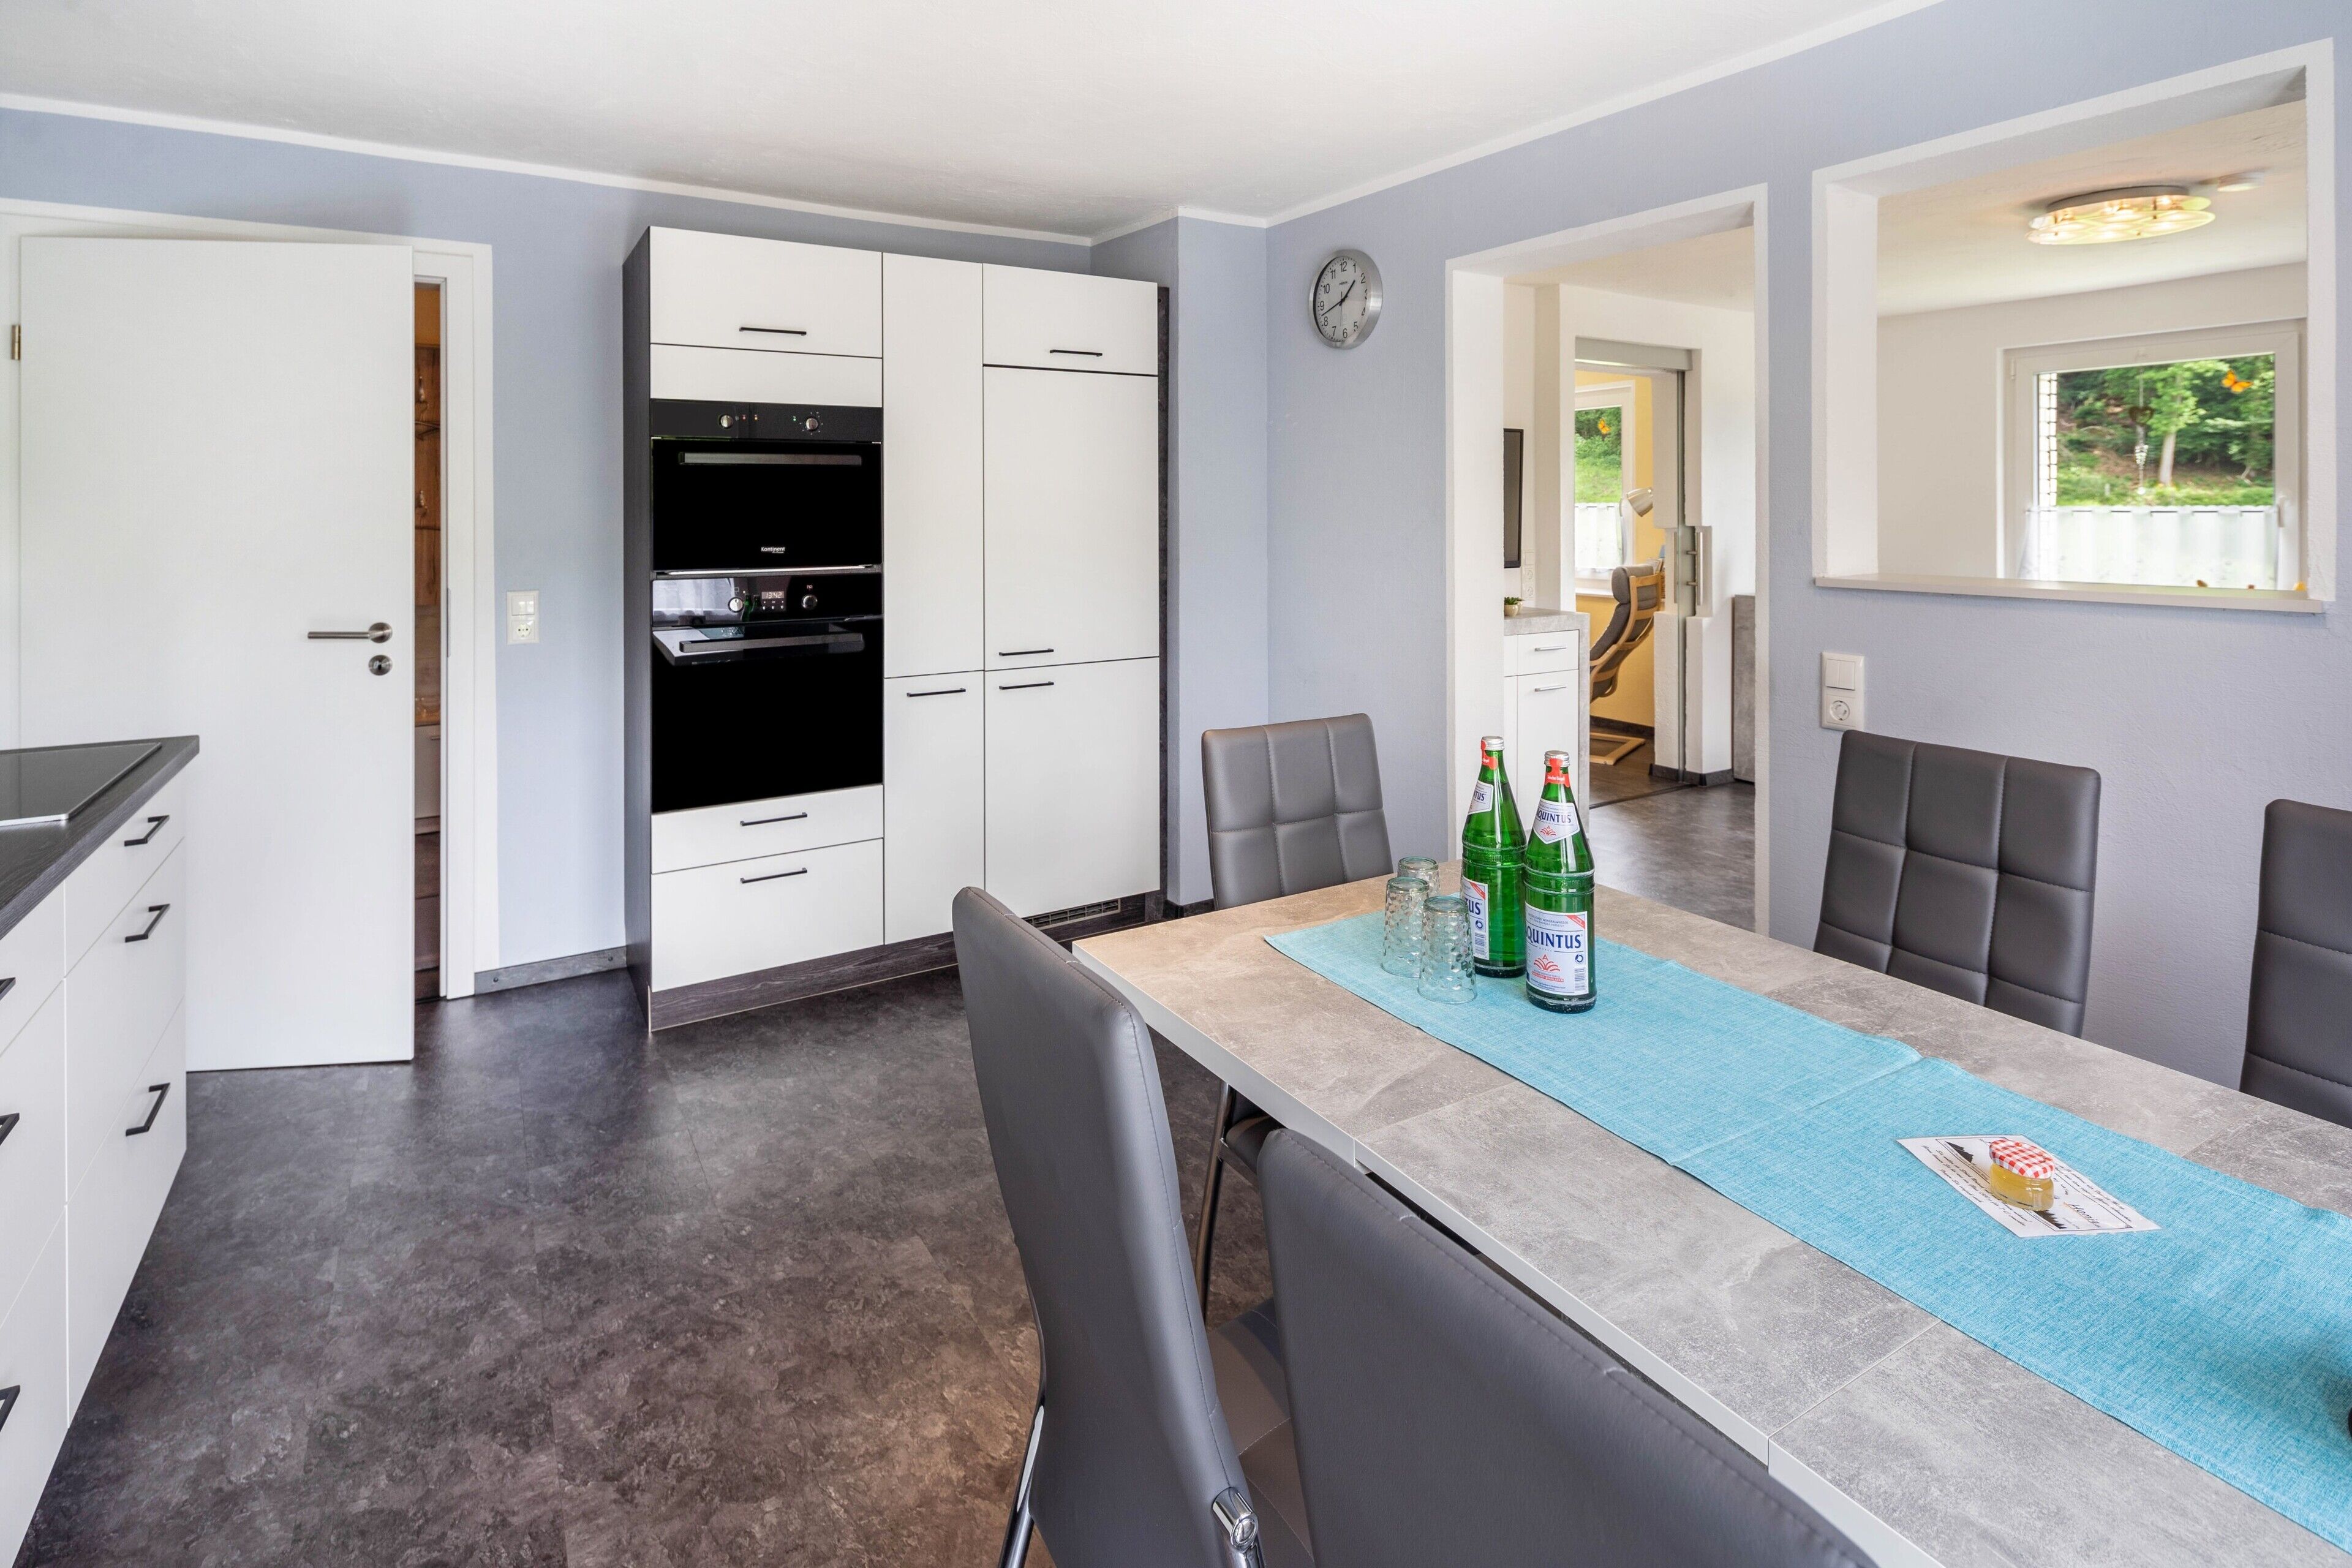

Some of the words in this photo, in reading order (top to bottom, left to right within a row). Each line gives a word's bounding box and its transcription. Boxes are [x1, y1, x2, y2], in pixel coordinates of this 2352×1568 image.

[1340, 261, 1347, 272] 12
[1353, 263, 1356, 273] 1
[1330, 269, 1336, 279] 11
[1360, 273, 1366, 284] 2
[1323, 283, 1330, 294] 10
[1320, 301, 1324, 311] 9
[1362, 307, 1365, 316] 4
[1324, 316, 1328, 326] 8
[1332, 326, 1336, 336] 7
[1354, 322, 1358, 332] 5
[1343, 328, 1348, 338] 6
[1526, 925, 1581, 949] QUINTUS
